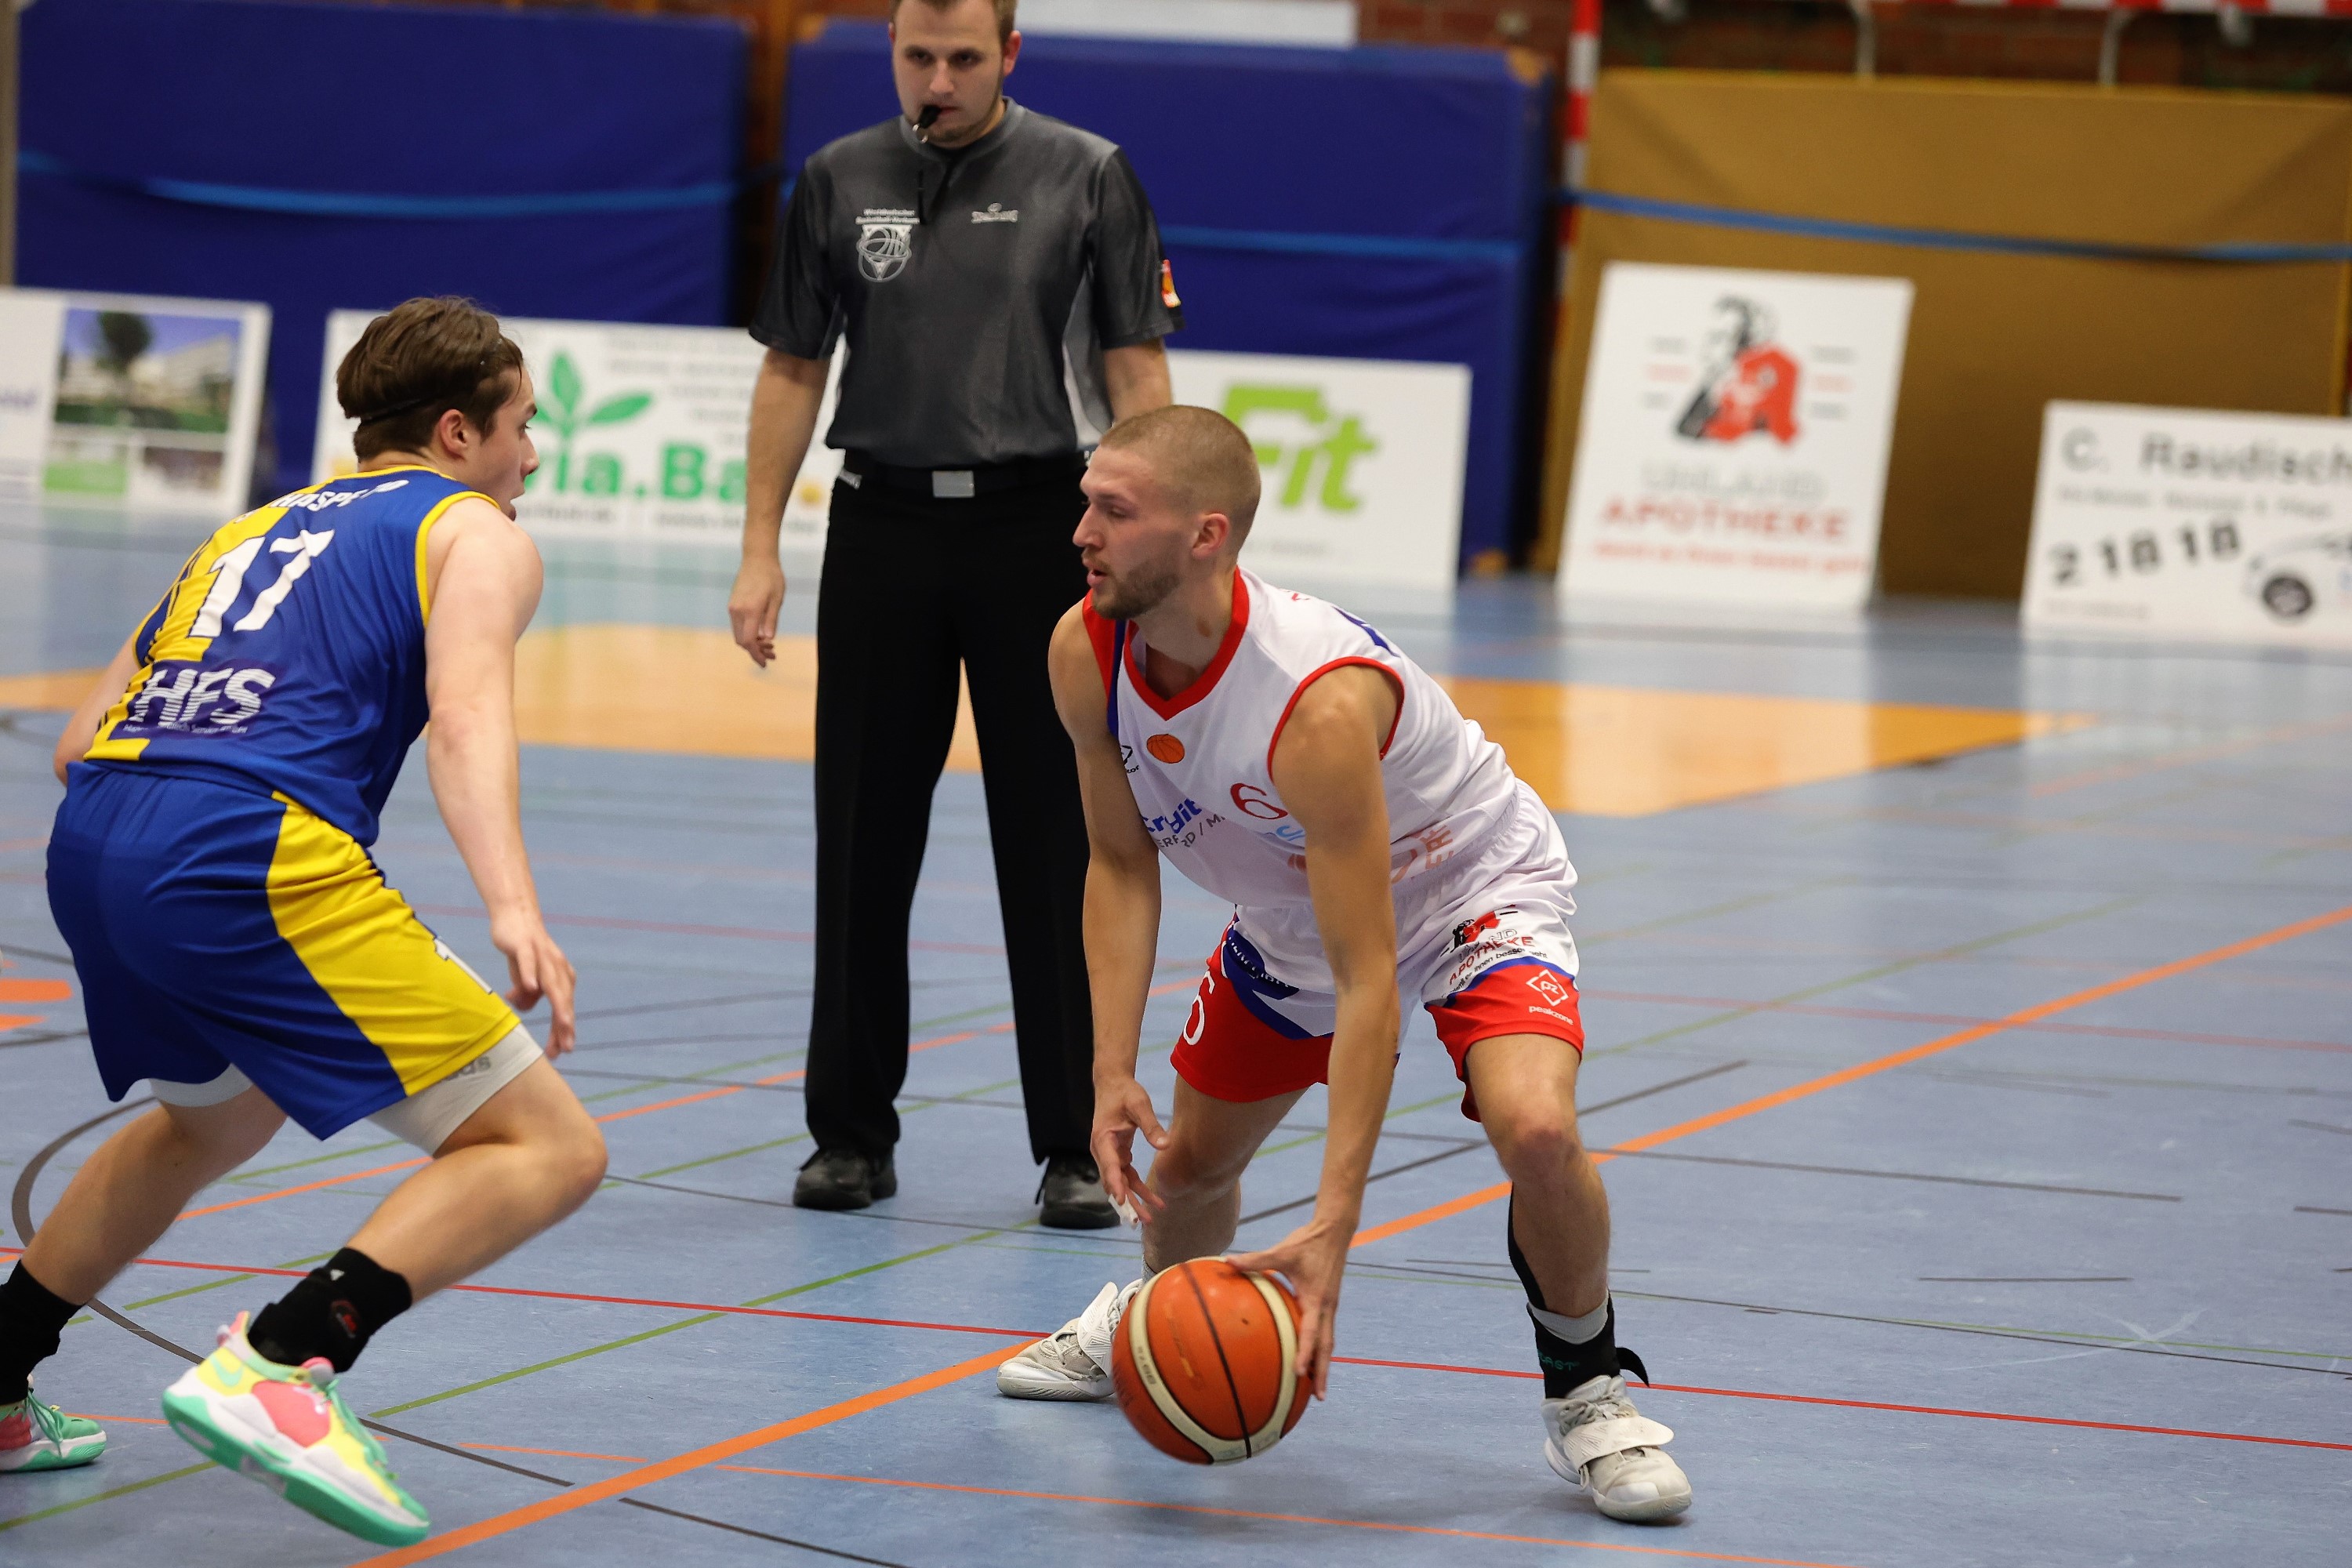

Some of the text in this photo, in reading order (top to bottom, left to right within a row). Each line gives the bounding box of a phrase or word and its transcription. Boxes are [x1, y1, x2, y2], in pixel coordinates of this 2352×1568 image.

[188, 528, 336, 638] 17
[129, 666, 277, 726] HFS
[1229, 782, 1288, 820] 6
[1449, 936, 1536, 985] APOTHEKE
[1528, 1005, 1573, 1025] peakzone
